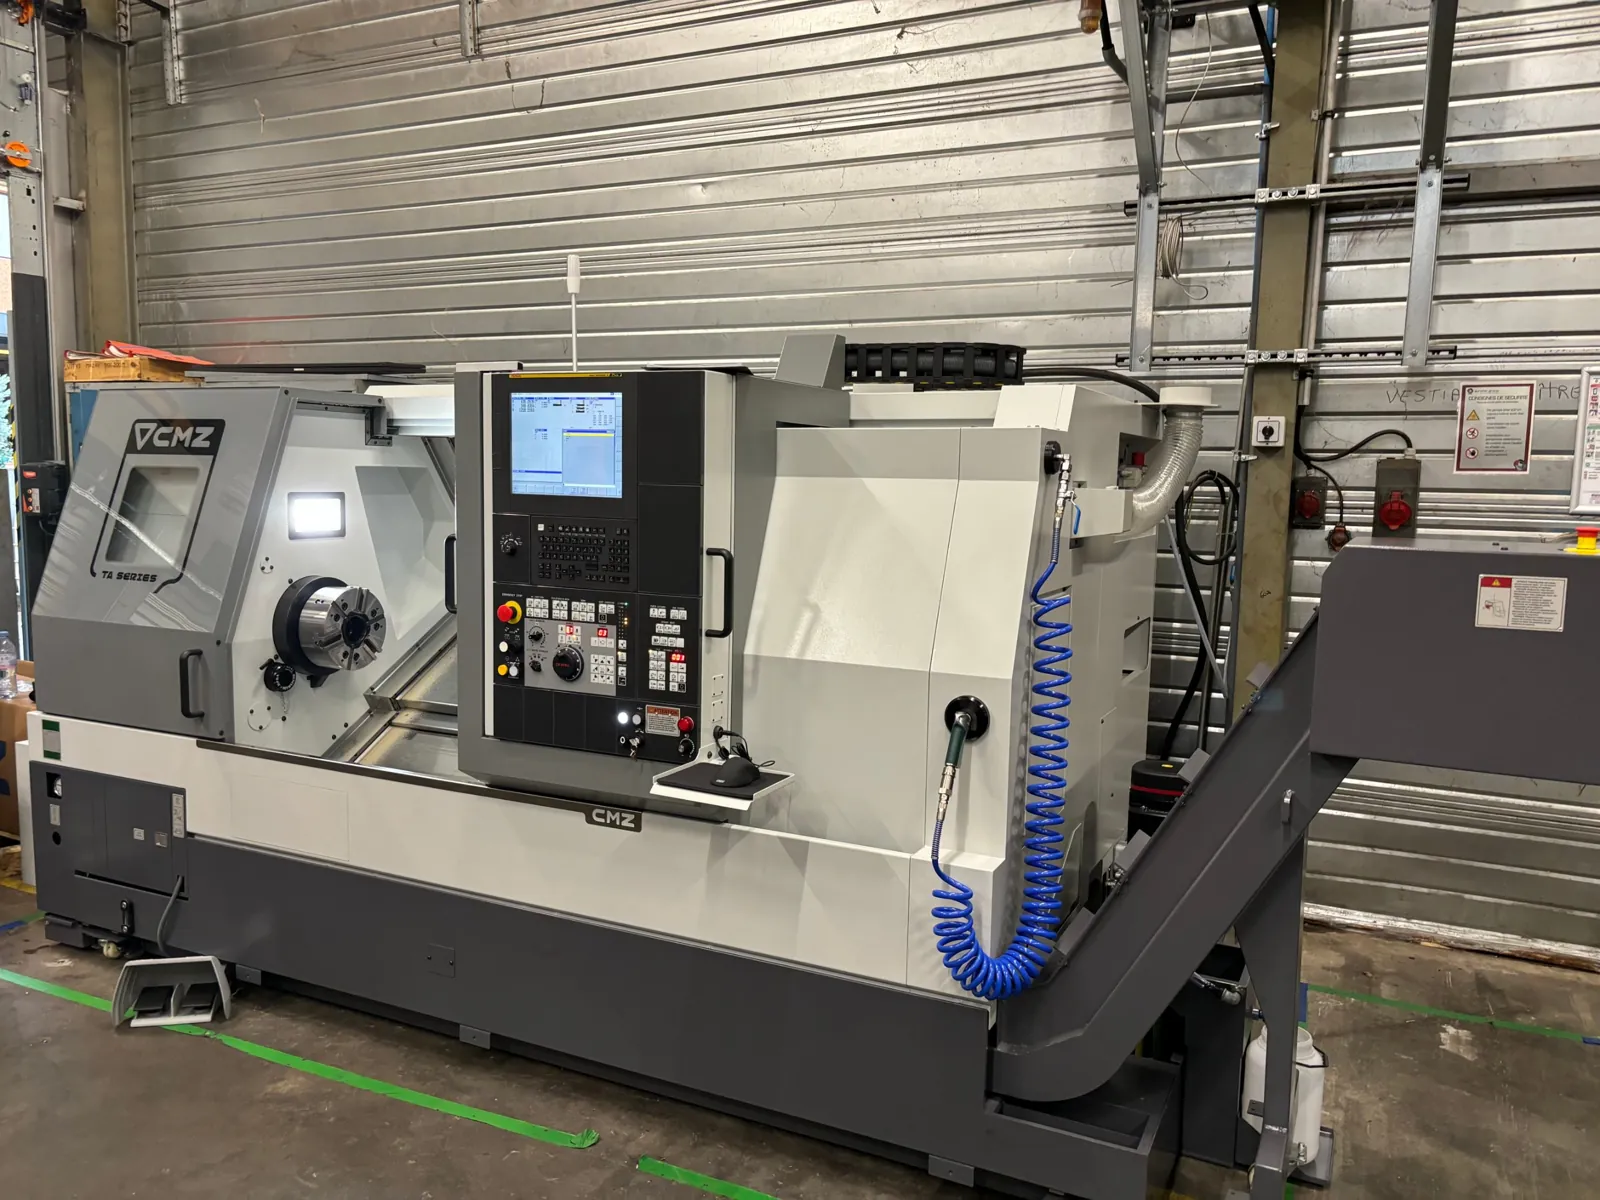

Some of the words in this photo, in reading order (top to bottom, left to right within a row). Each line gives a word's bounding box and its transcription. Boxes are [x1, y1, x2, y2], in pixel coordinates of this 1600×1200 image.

[153, 426, 215, 448] CMZ
[102, 570, 113, 579] TA
[116, 571, 158, 582] SERIES
[592, 808, 635, 828] CMZ
